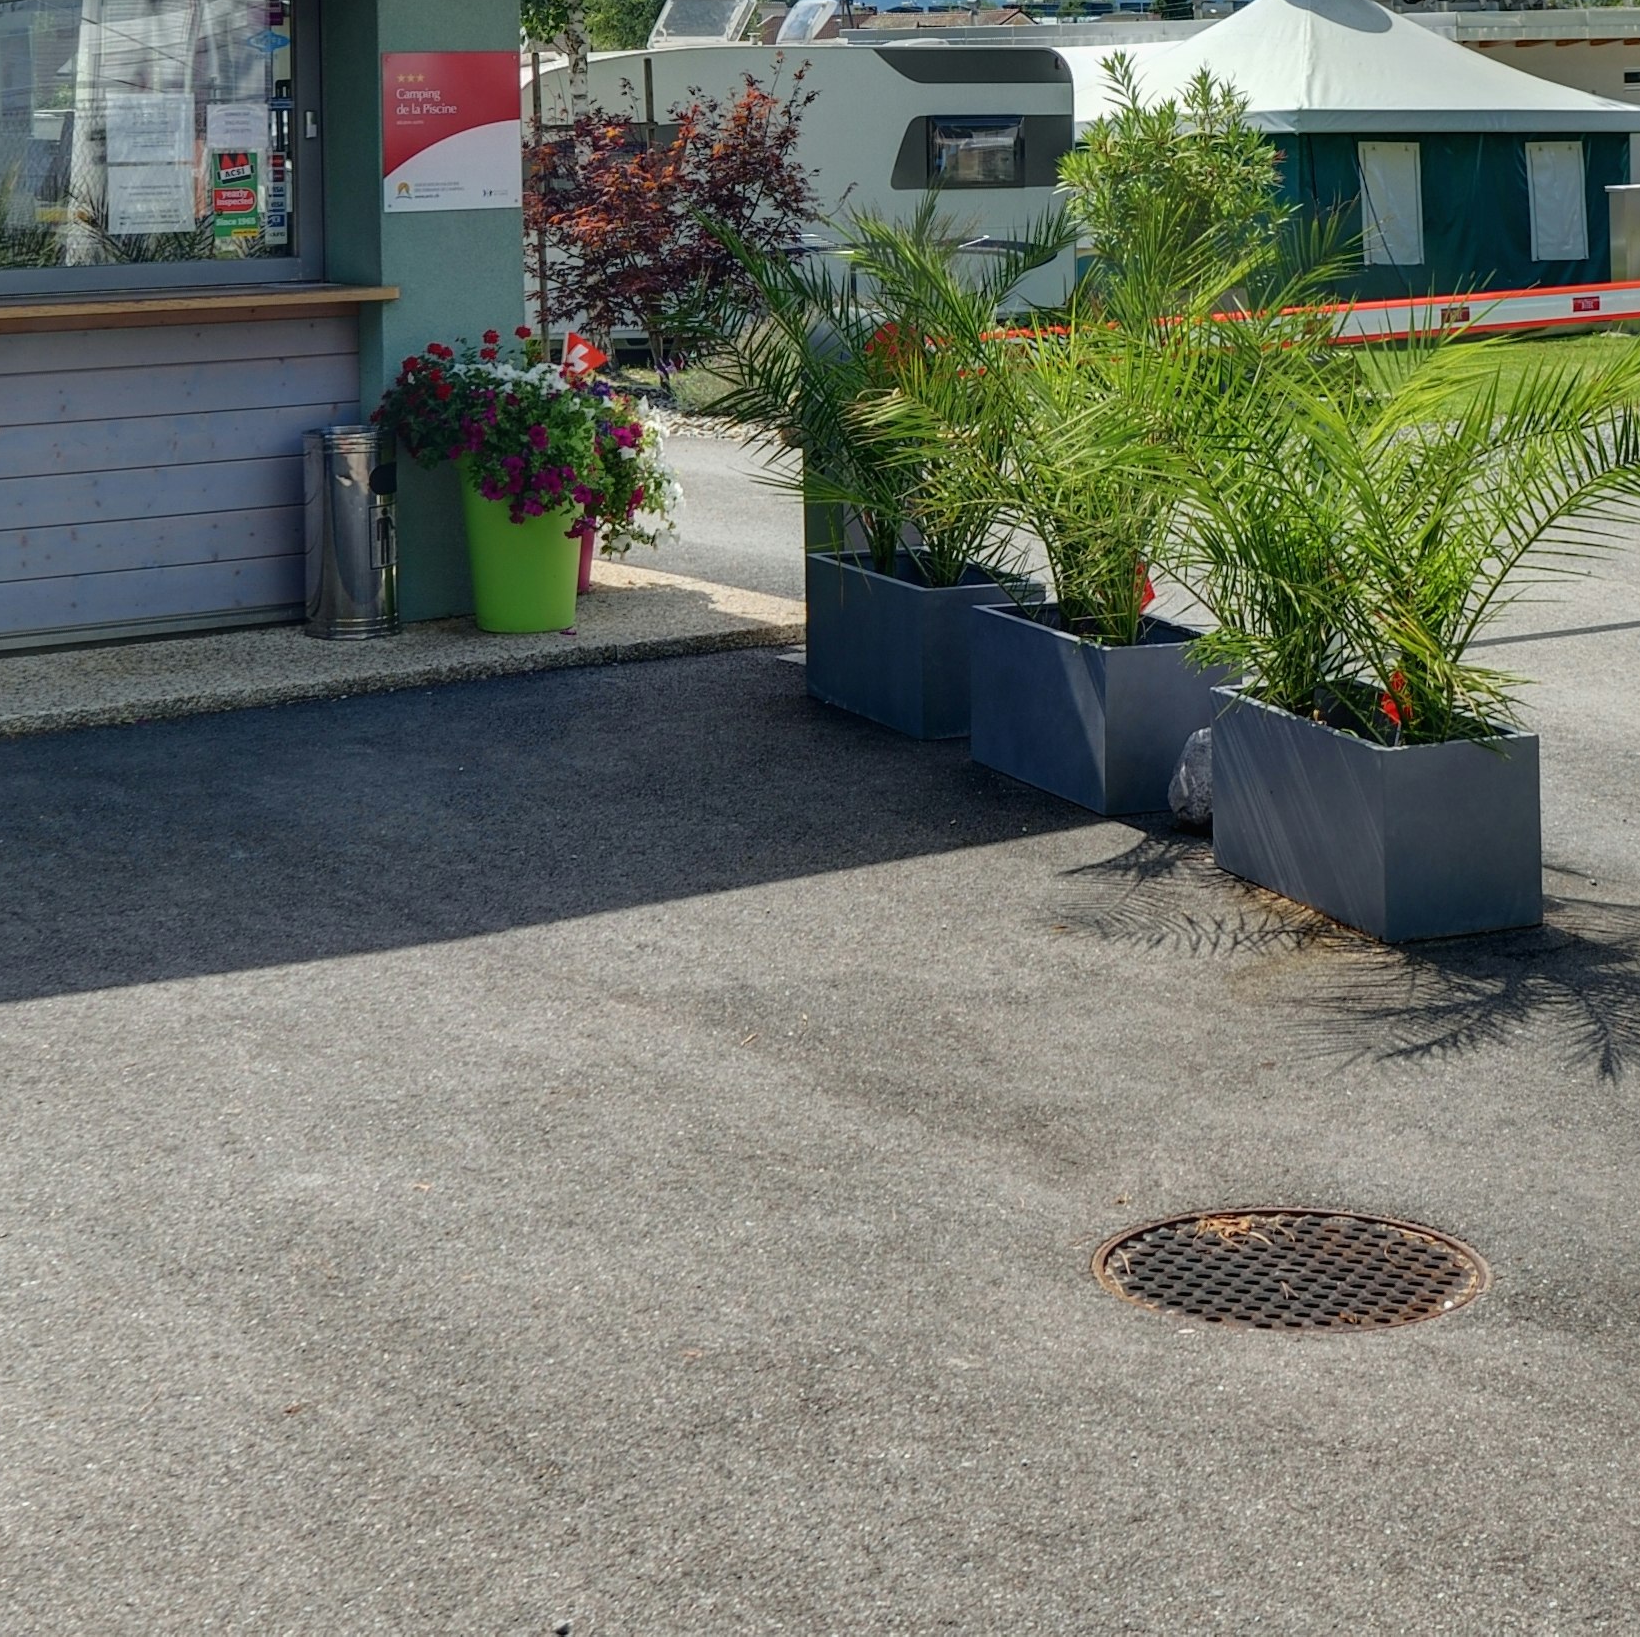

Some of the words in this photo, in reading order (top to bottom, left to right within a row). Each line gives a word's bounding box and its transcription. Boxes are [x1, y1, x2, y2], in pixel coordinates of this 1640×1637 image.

[395, 88, 441, 102] Camping
[396, 103, 409, 115] de
[411, 103, 421, 114] la
[423, 103, 457, 114] Piscine
[224, 167, 246, 178] ACSI
[222, 190, 249, 199] yearly
[216, 197, 254, 207] inspected
[216, 217, 237, 226] Since
